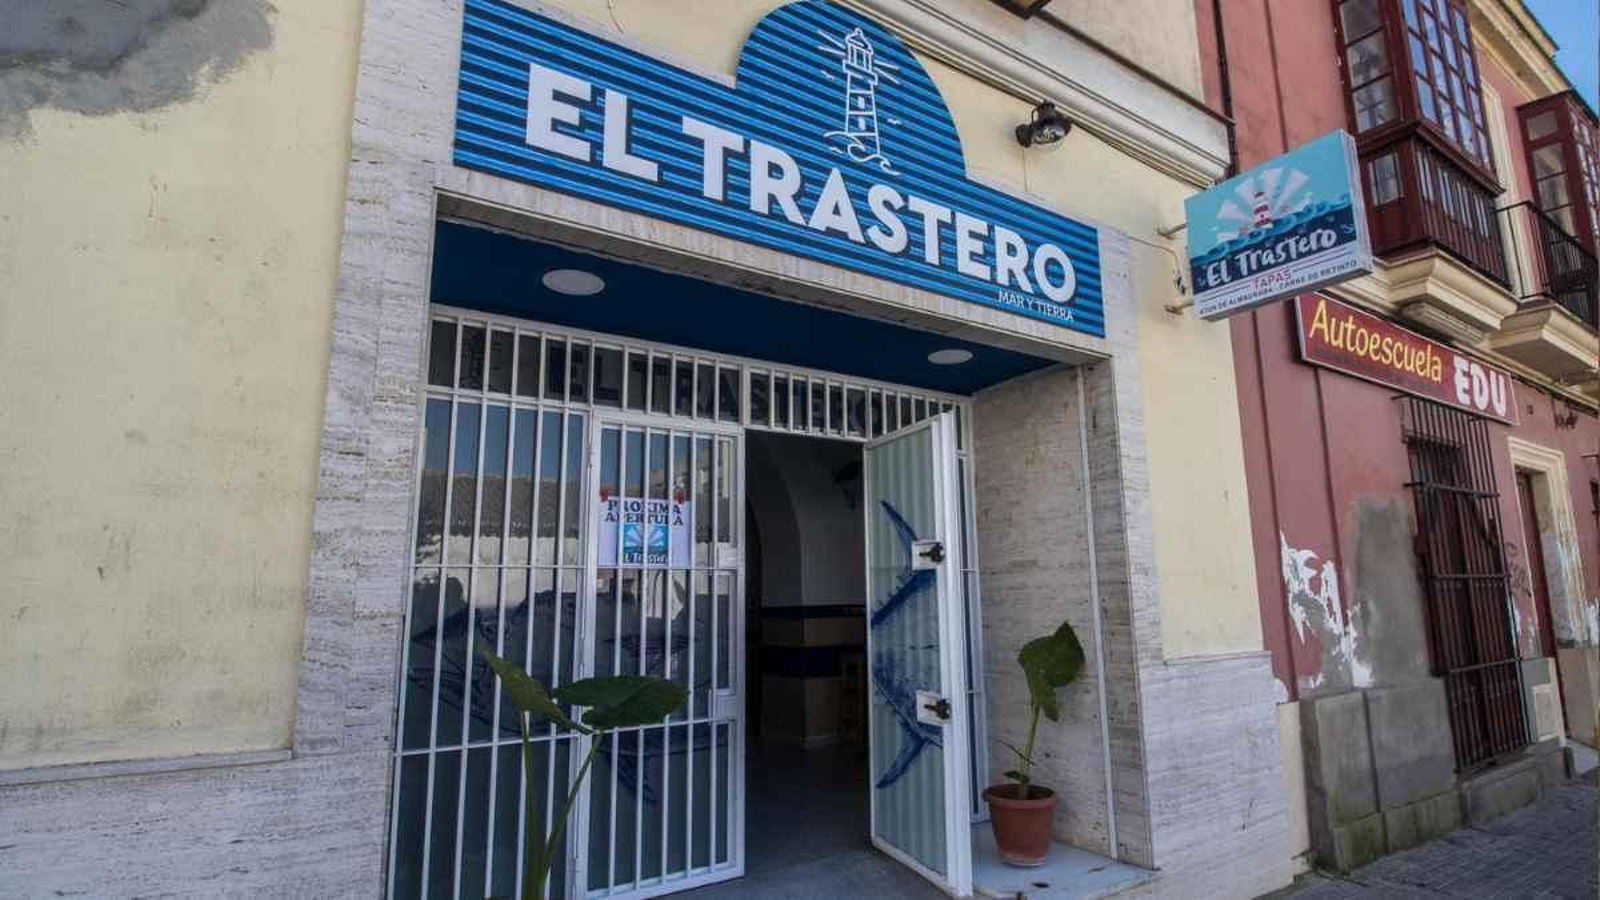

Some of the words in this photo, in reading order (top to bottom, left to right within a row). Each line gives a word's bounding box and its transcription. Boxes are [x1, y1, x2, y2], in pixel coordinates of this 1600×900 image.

[525, 62, 659, 183] EL
[681, 114, 1077, 303] TRASTERO
[1206, 258, 1232, 287] El
[1253, 266, 1292, 289] TAPAS
[998, 290, 1025, 310] MAR
[1035, 301, 1075, 321] TIERRA
[1309, 299, 1442, 384] Autoescuela
[1453, 352, 1506, 417] EDU
